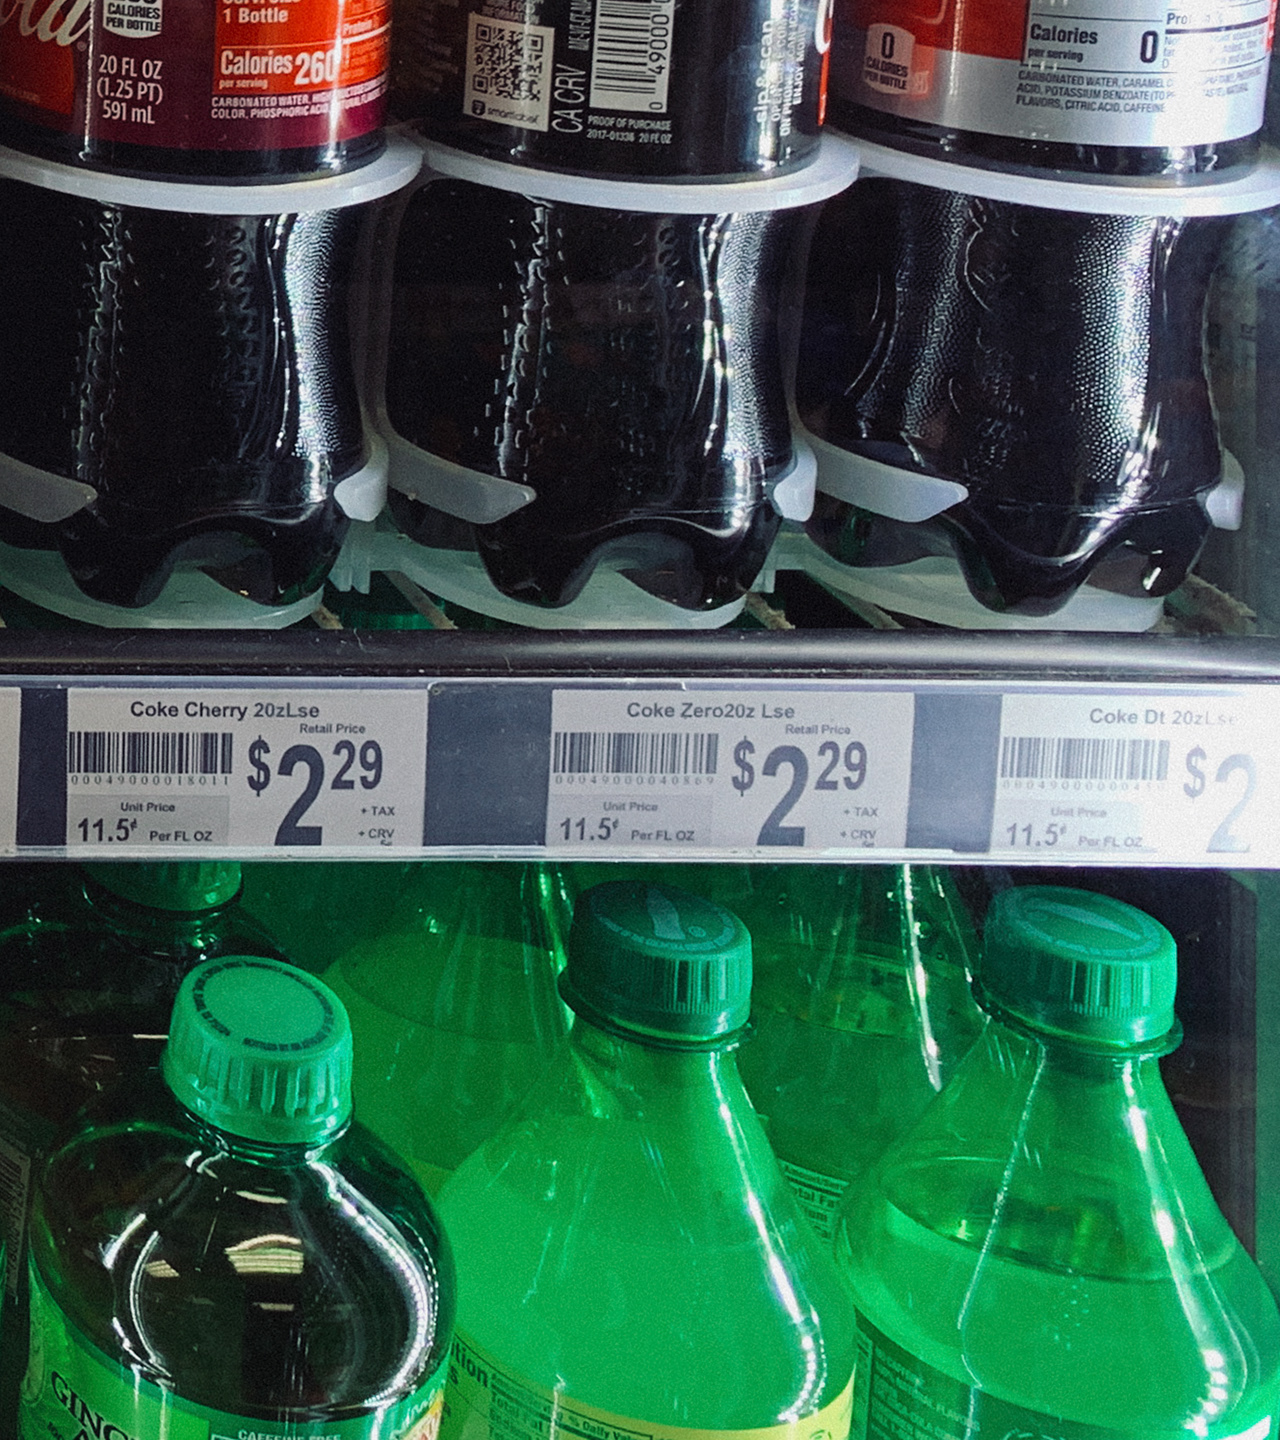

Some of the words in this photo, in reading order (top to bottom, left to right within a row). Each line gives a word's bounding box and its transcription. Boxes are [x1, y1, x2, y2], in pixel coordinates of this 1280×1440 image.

[1030, 25, 1098, 44] Calories
[1140, 31, 1158, 62] 0
[220, 51, 292, 74] Calories
[295, 51, 338, 84] 260
[552, 64, 586, 102] CRV
[552, 108, 585, 134] CA
[131, 702, 179, 718] Coke
[184, 702, 247, 720] Cherry
[627, 703, 674, 719] Coke
[761, 703, 794, 719] Lse
[299, 724, 333, 734] Retail
[338, 724, 365, 734] Price
[121, 803, 143, 812] Unit
[147, 803, 175, 812] Price
[149, 831, 171, 842] Per
[174, 831, 190, 842] FL
[194, 831, 212, 842] OZ
